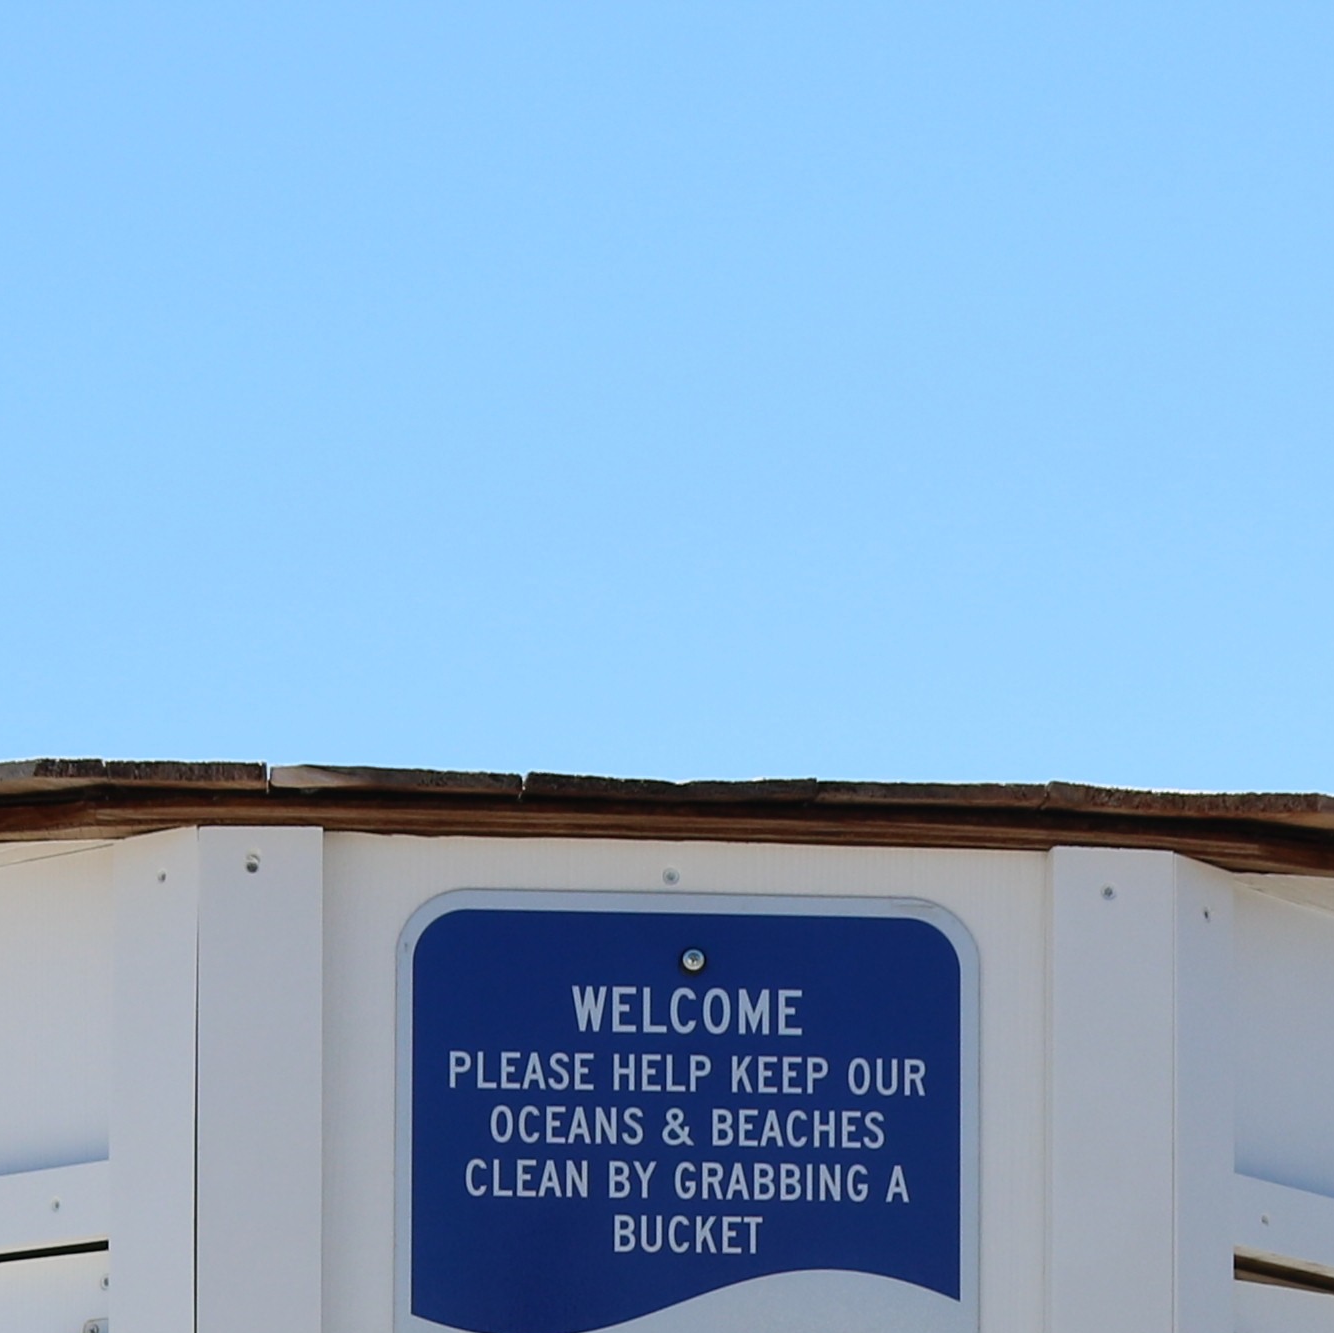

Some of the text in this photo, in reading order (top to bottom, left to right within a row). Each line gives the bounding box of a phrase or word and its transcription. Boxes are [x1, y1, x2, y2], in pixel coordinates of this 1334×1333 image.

[571, 985, 803, 1036] WELCOME
[449, 1050, 926, 1097] PLEASE HELP KEEP OUR
[490, 1104, 885, 1149] OCEANS & BEACHES
[465, 1158, 910, 1203] CLEAN BY GRABBING A
[613, 1214, 764, 1254] BUCKET
